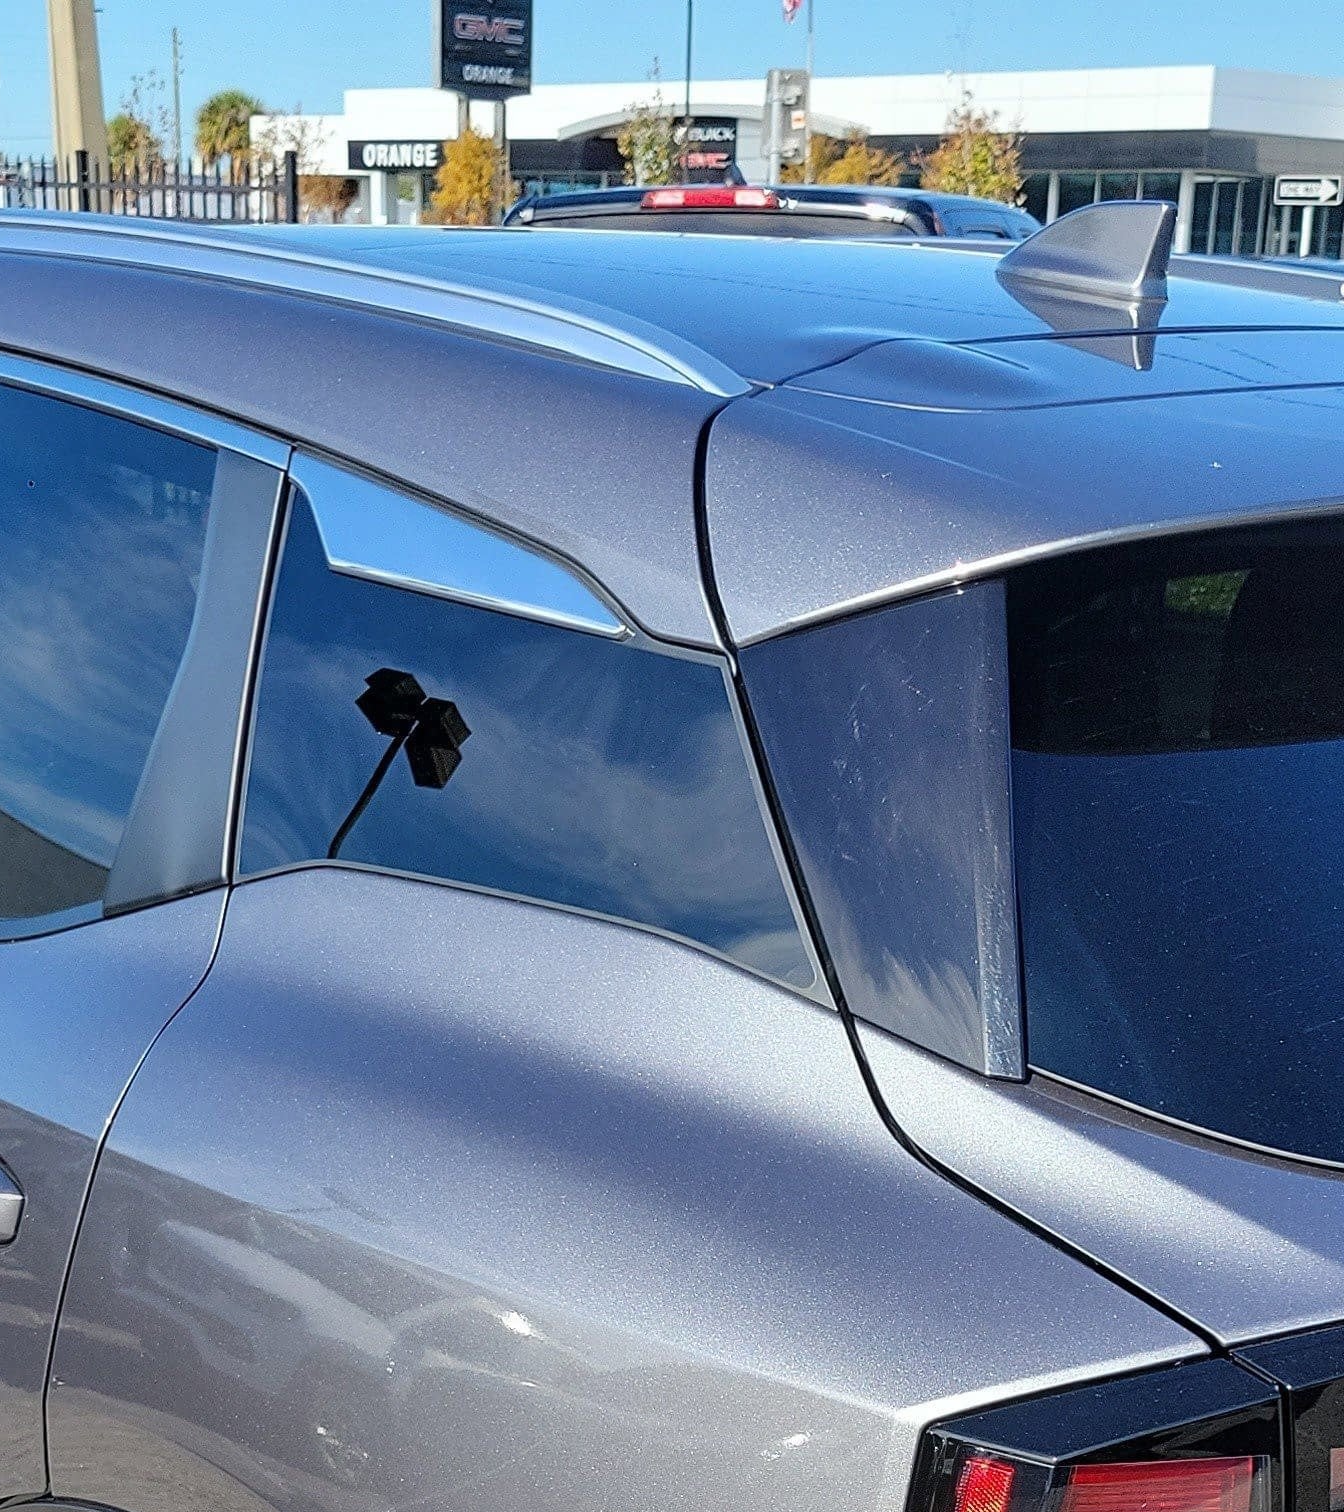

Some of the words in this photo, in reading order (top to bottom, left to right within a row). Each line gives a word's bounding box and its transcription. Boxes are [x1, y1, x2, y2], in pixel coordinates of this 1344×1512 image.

[453, 13, 525, 45] GMC
[462, 64, 515, 85] ORANGE
[362, 143, 438, 168] ORANGE
